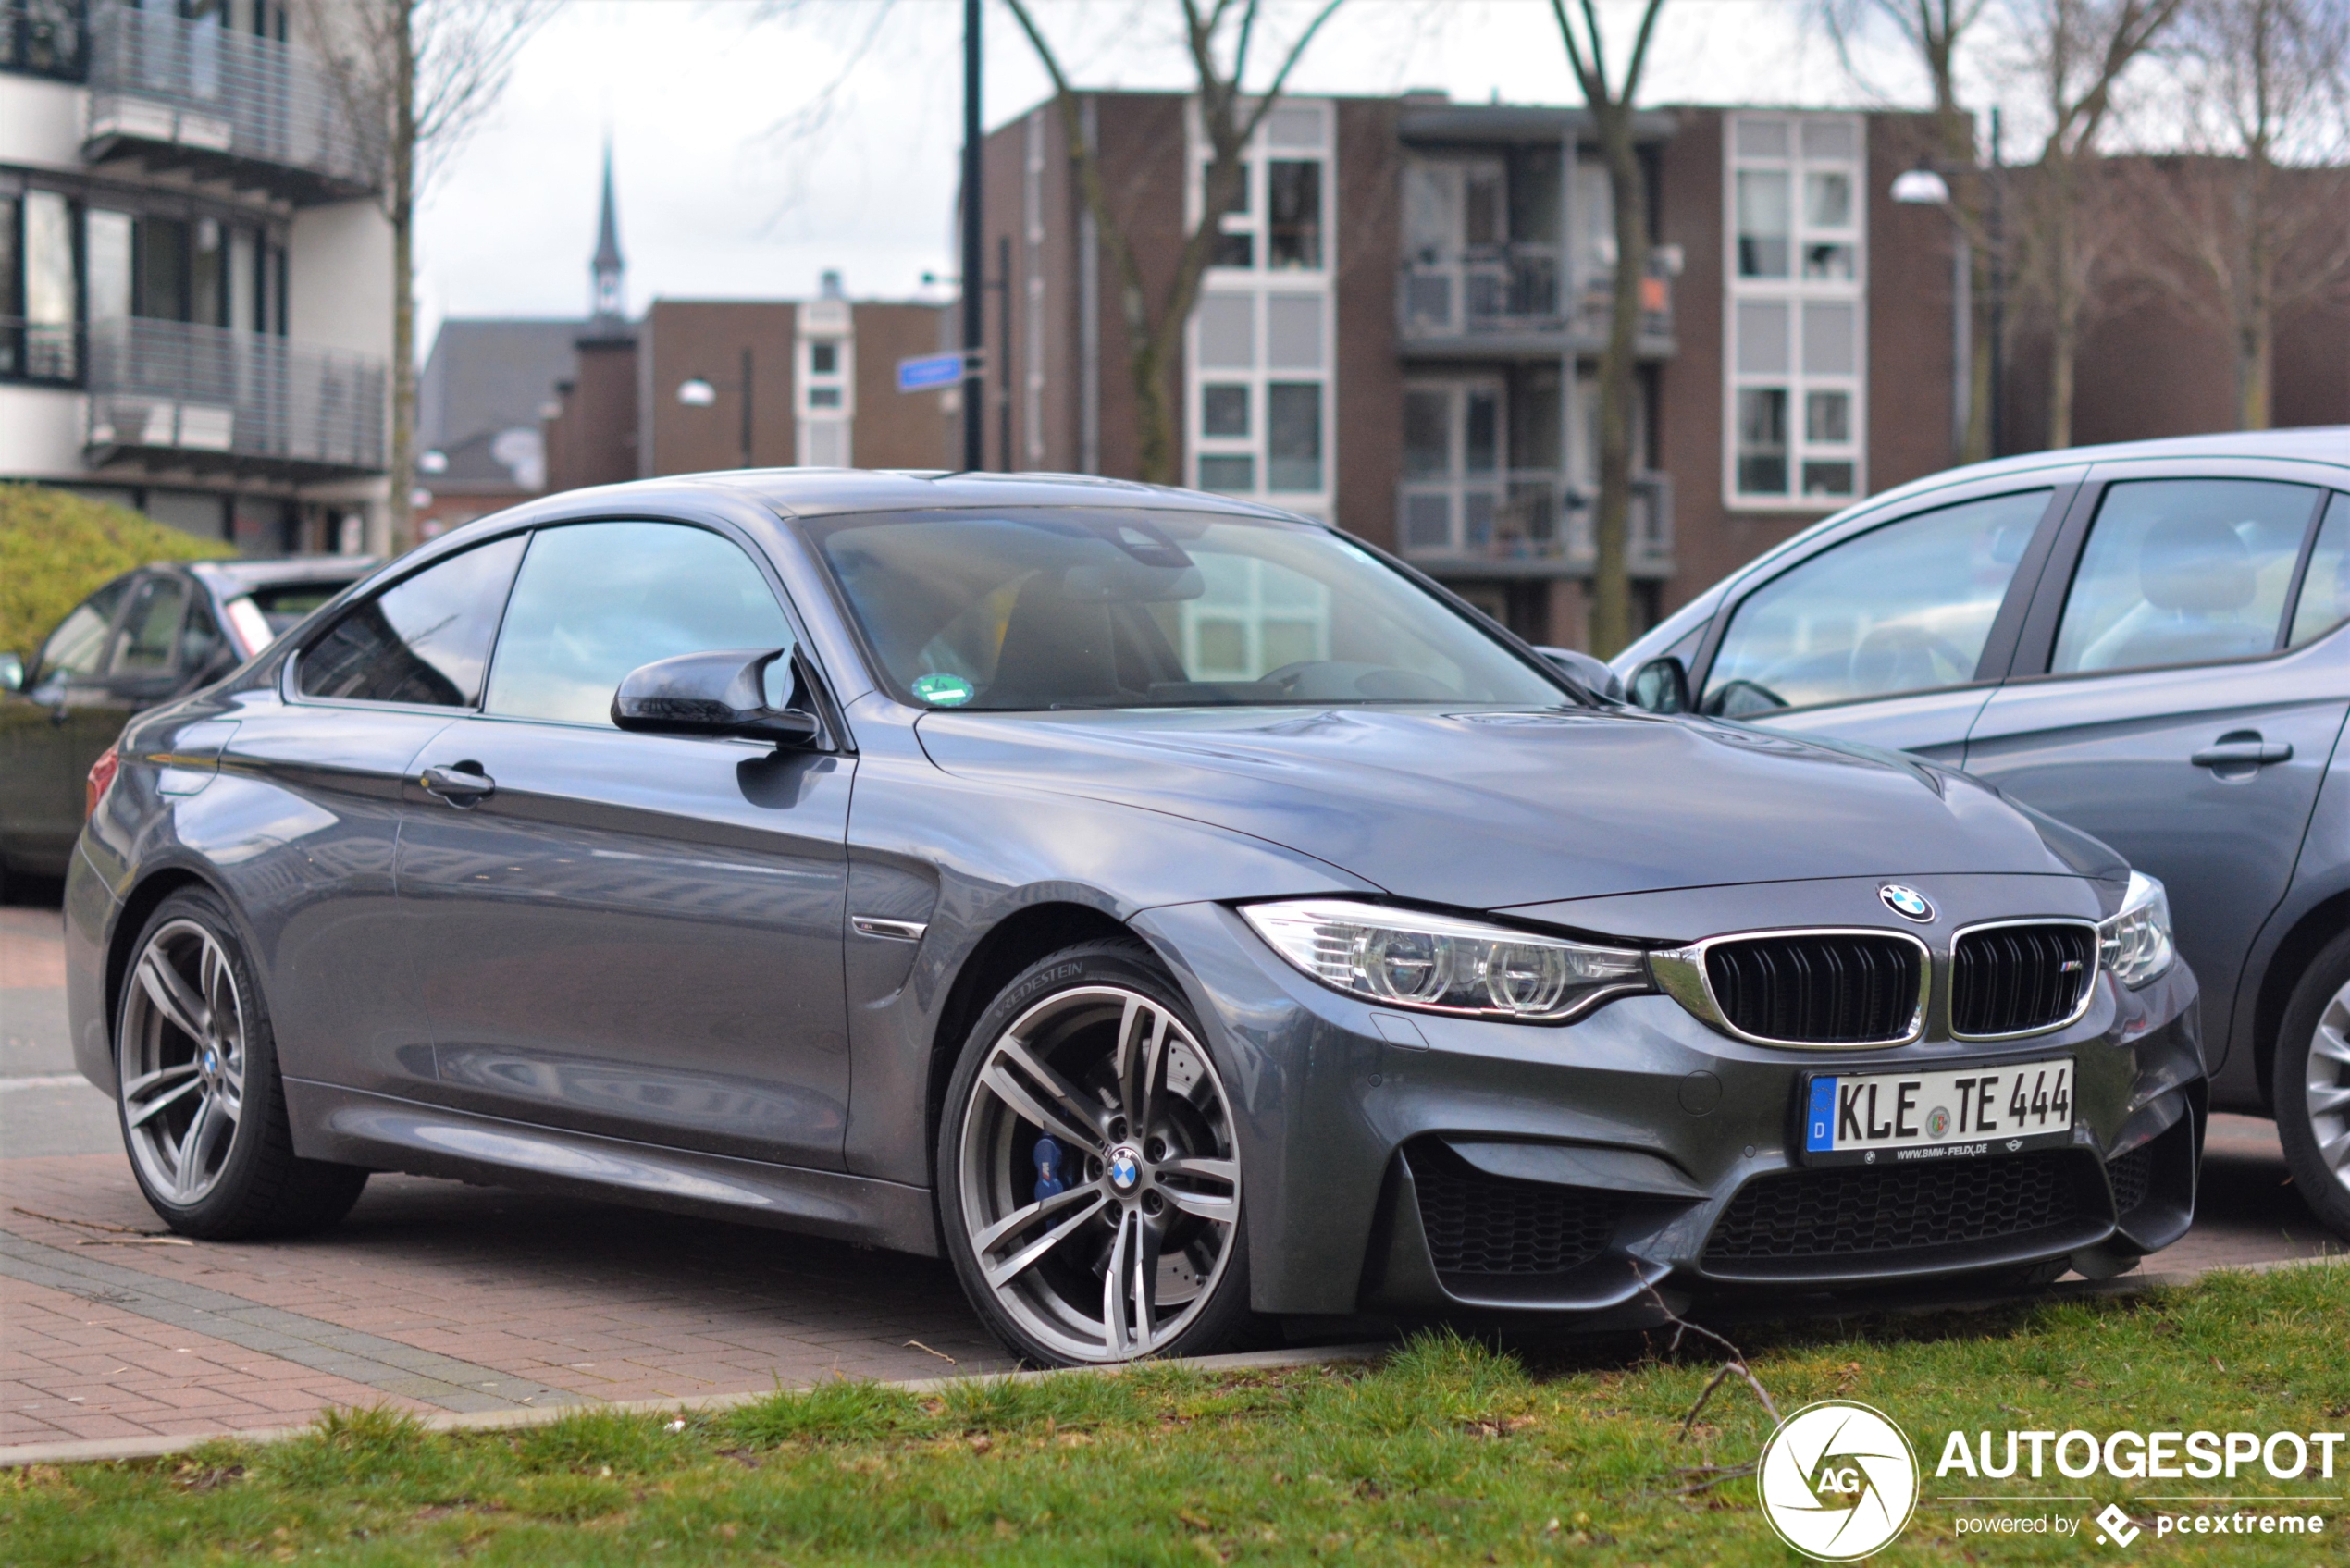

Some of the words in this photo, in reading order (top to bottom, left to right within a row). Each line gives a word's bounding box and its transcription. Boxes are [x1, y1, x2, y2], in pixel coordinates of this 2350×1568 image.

[934, 677, 949, 691] 4
[995, 961, 1083, 1019] VREDESTEIN
[1838, 1081, 1922, 1142] KLE
[1954, 1075, 1999, 1134] TE
[2008, 1068, 2070, 1129] 444
[1813, 1121, 1825, 1140] D
